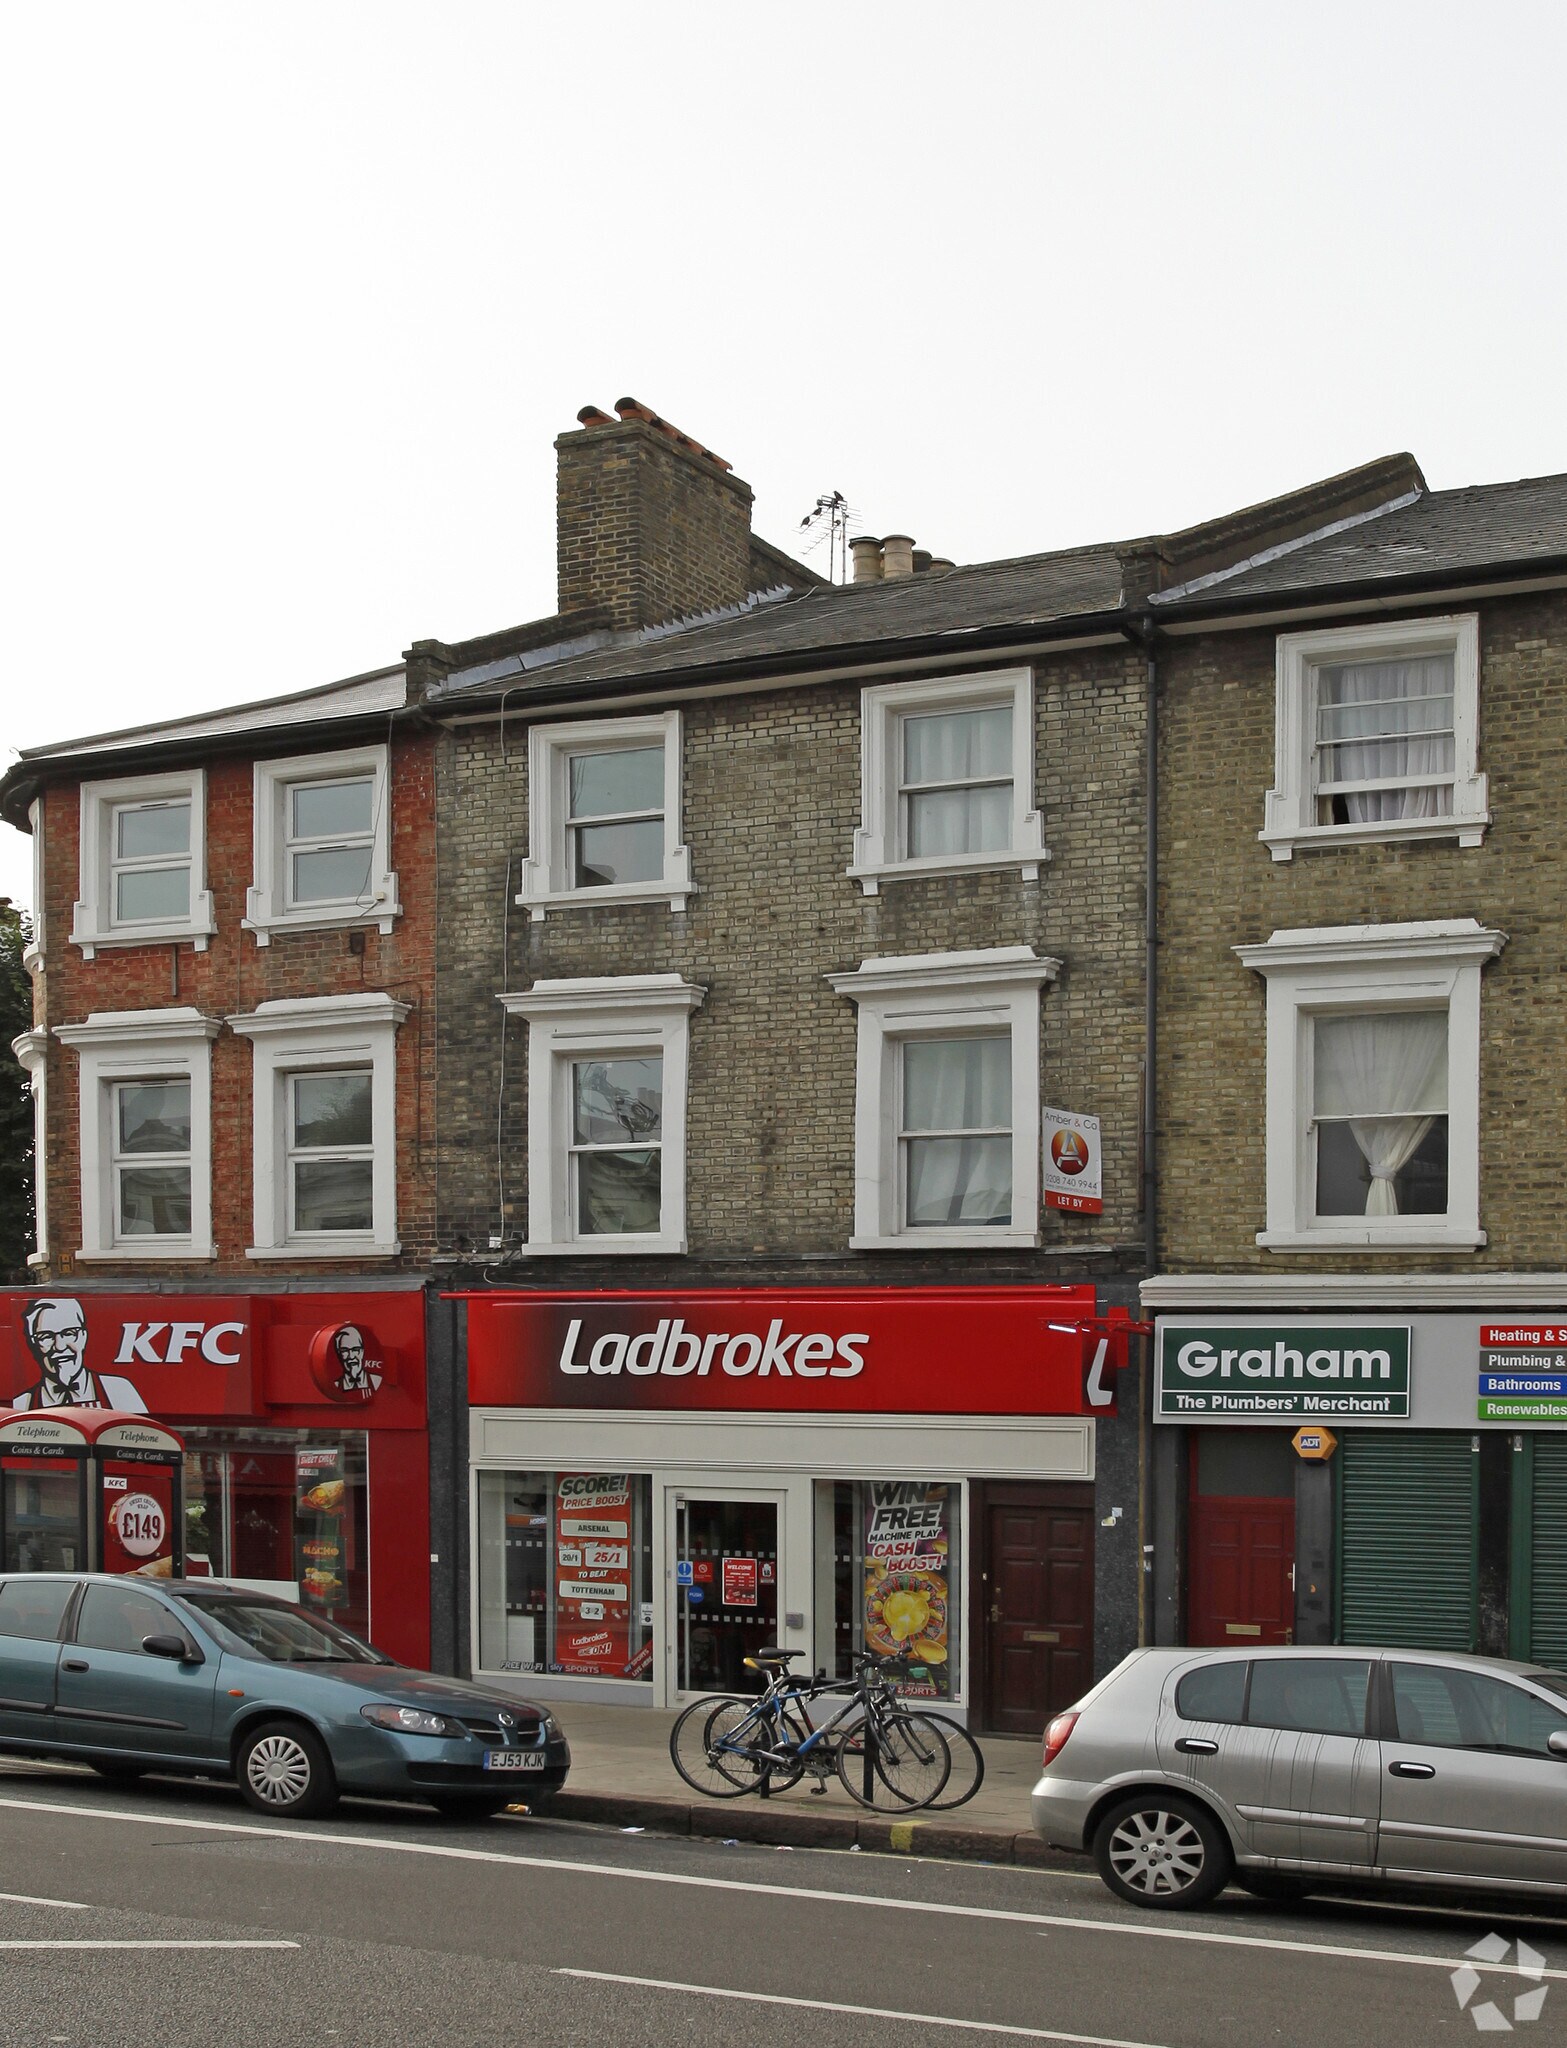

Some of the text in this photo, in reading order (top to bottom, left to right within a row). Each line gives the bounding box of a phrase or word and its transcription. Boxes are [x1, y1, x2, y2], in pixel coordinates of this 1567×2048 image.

[1045, 1112, 1098, 1130] Amber & Co
[1045, 1173, 1098, 1190] 0208 740 9944
[1057, 1196, 1084, 1208] LET BY
[1489, 1329, 1541, 1344] Heating
[1544, 1329, 1555, 1342] &
[114, 1322, 244, 1365] KFC
[559, 1319, 870, 1377] Ladbrokes
[364, 1360, 383, 1369] KFC
[1177, 1340, 1391, 1379] Graham
[1488, 1354, 1566, 1369] Plumbing &
[1488, 1378, 1562, 1391] Bathrooms
[1176, 1394, 1391, 1412] The Plumbers' Merchant
[1487, 1403, 1567, 1416] Renewables
[16, 1425, 61, 1438] Telephone
[119, 1430, 160, 1443] Telephone
[1301, 1436, 1321, 1448] ADT
[11, 1445, 65, 1456] Coins & Cards
[116, 1450, 165, 1462] Coins & Cards
[108, 1479, 126, 1488] KFC
[560, 1475, 626, 1496] SCORE!
[871, 1481, 929, 1506] WIN
[565, 1494, 627, 1508] PRICE BOOST
[874, 1504, 941, 1531] FREE
[122, 1512, 161, 1540] £1.49
[577, 1524, 611, 1533] ARSENAL
[869, 1530, 912, 1543] MACHINE
[873, 1541, 915, 1557] CASH
[562, 1551, 621, 1564] 20/1 25/1
[887, 1555, 943, 1573] BOOST!
[578, 1569, 609, 1579] TO BEAT
[571, 1585, 615, 1596] TOTTENHAM
[572, 1631, 609, 1646] Ladbrokes
[592, 1641, 613, 1655] ON!
[500, 1661, 520, 1670] FREE
[549, 1664, 600, 1674] sky SPORTS
[897, 1686, 937, 1696] SPORTS
[491, 1753, 544, 1767] EJ53 KJK
